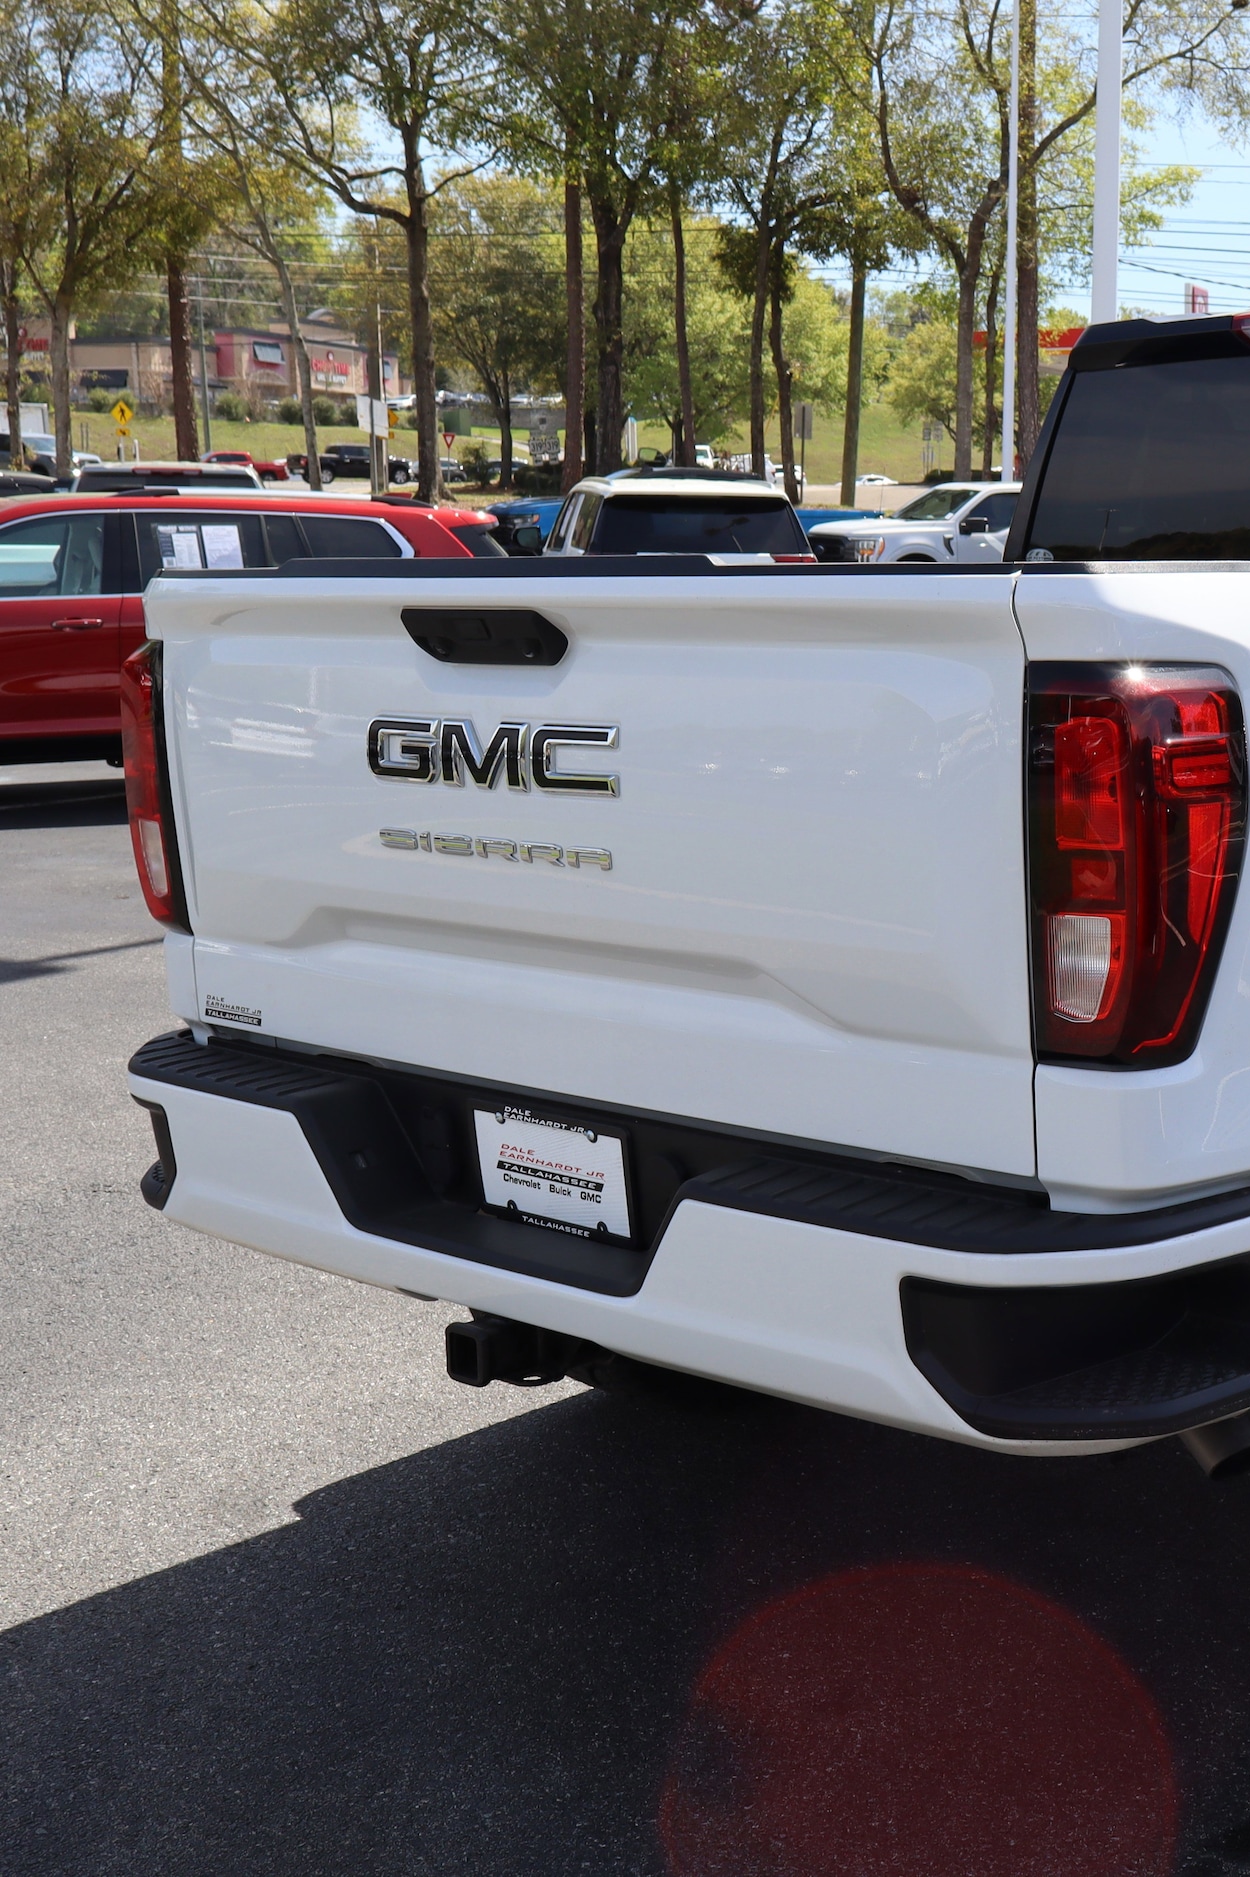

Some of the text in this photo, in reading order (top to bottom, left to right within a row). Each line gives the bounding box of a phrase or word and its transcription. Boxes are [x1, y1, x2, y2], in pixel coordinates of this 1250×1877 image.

[367, 717, 619, 797] GMC
[379, 827, 612, 871] SIERRA
[205, 1000, 250, 1013] EARNHARDT
[206, 994, 225, 1002] DALE
[207, 1009, 259, 1025] TALLAHASSEE
[503, 1105, 532, 1117] DALE
[503, 1112, 568, 1130] EARNHARDT
[500, 1143, 536, 1156] DALE
[499, 1150, 605, 1179] EARNHARDT JR
[502, 1163, 597, 1190] TALLAHASSEE
[503, 1173, 602, 1204] Chevrolet Buick GMC
[522, 1214, 591, 1238] TALLAHASSEE
